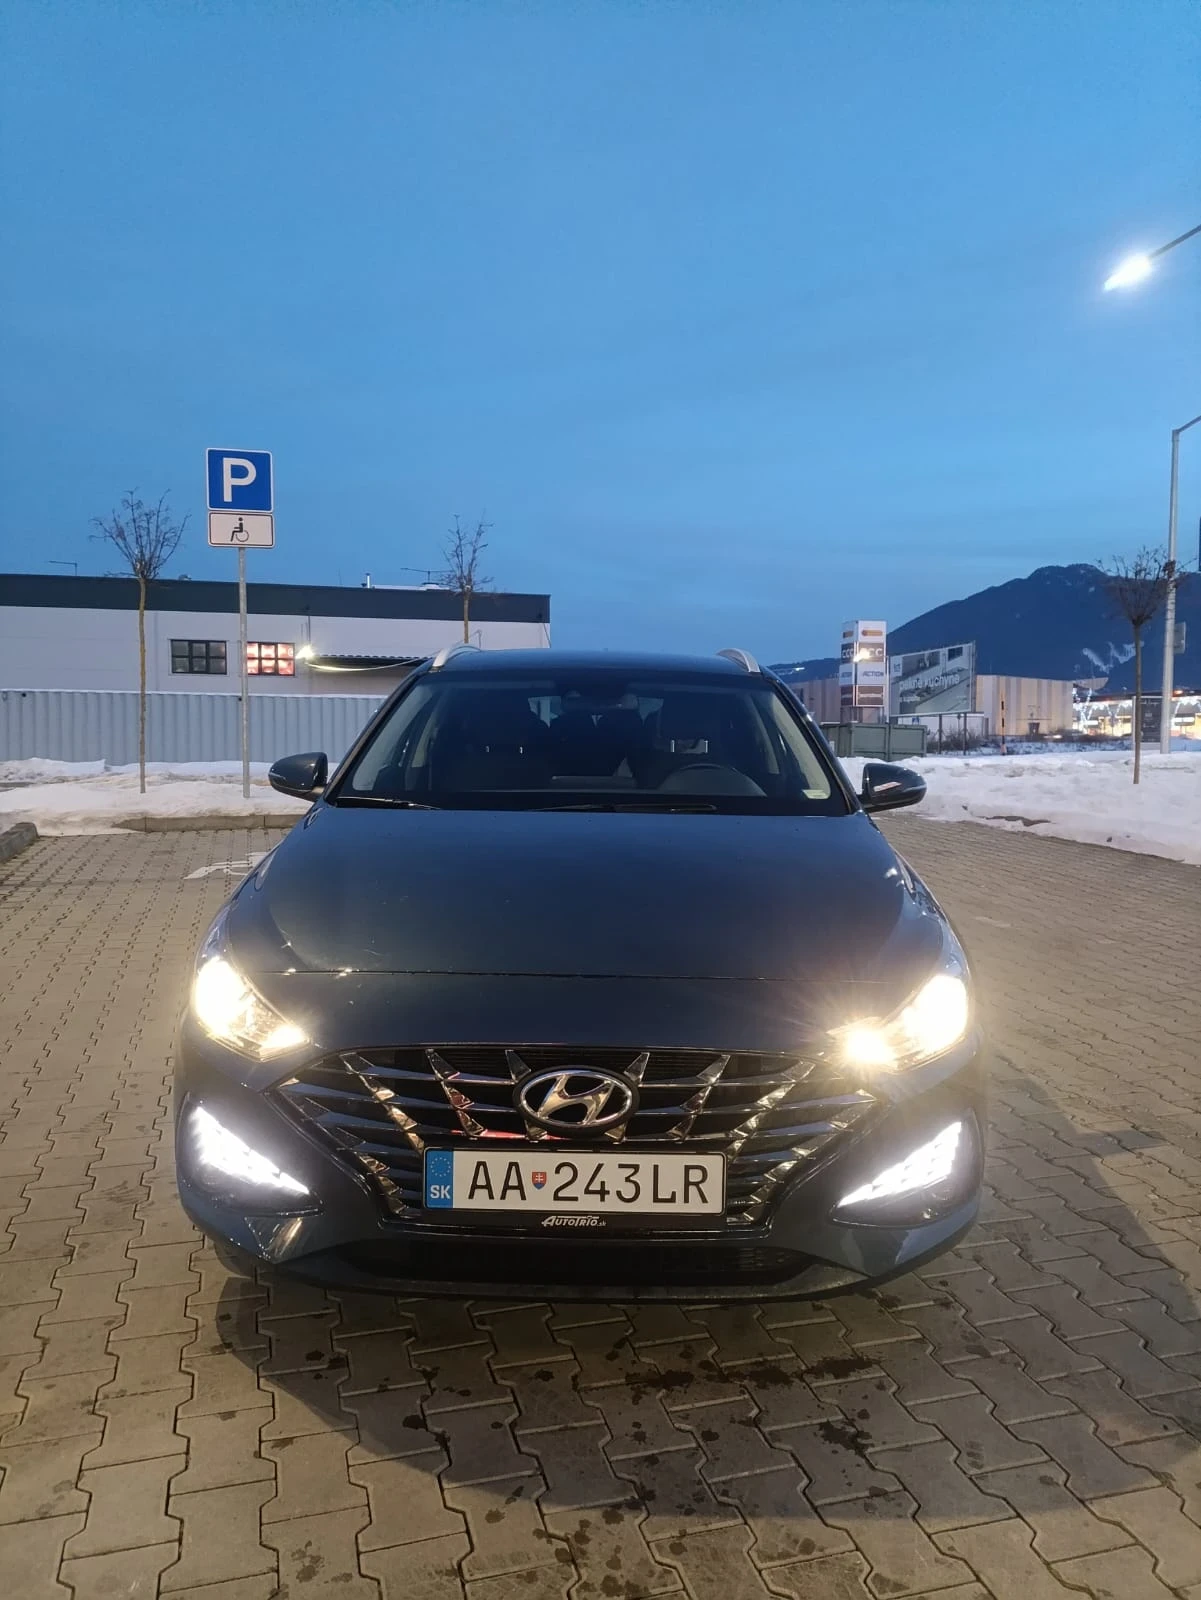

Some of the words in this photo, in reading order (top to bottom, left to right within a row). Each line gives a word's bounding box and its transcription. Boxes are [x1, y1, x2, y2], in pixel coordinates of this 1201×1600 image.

[222, 457, 257, 503] P
[860, 647, 883, 657] CC
[429, 1184, 451, 1199] SK
[468, 1160, 527, 1201] AA
[553, 1162, 709, 1204] 243LR
